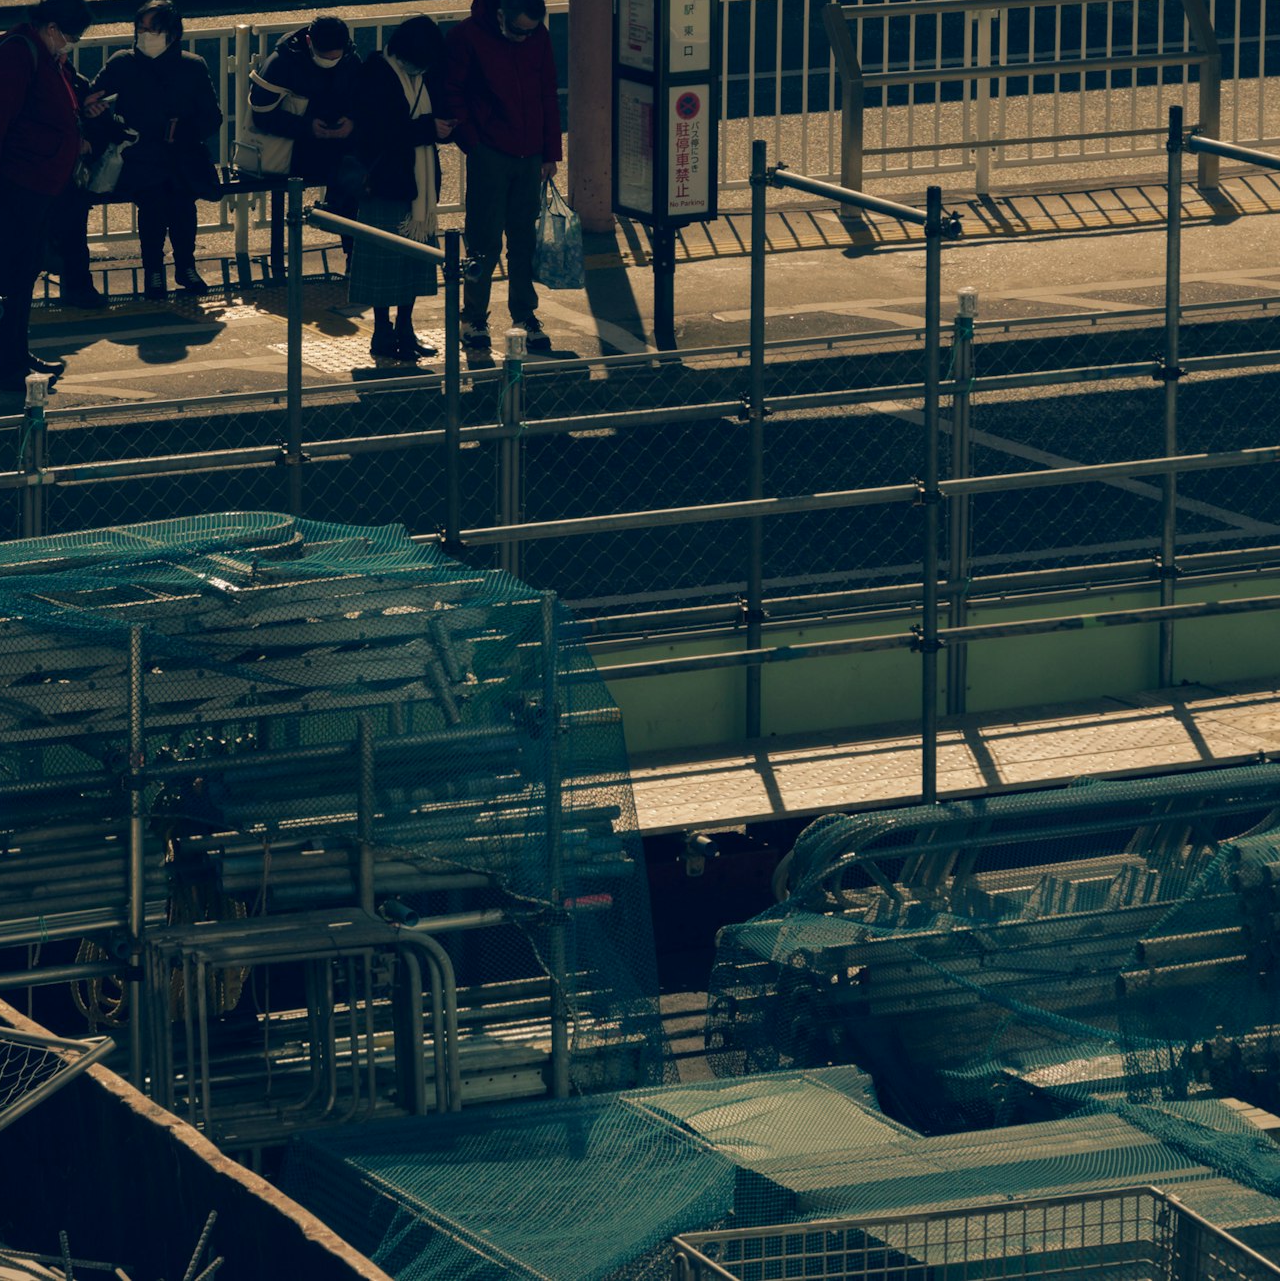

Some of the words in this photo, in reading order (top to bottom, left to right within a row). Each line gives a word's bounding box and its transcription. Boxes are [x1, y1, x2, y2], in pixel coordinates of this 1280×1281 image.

[675, 121, 690, 199] 駐停車禁止
[690, 120, 700, 174] バス停につき
[680, 198, 706, 209] Parking
